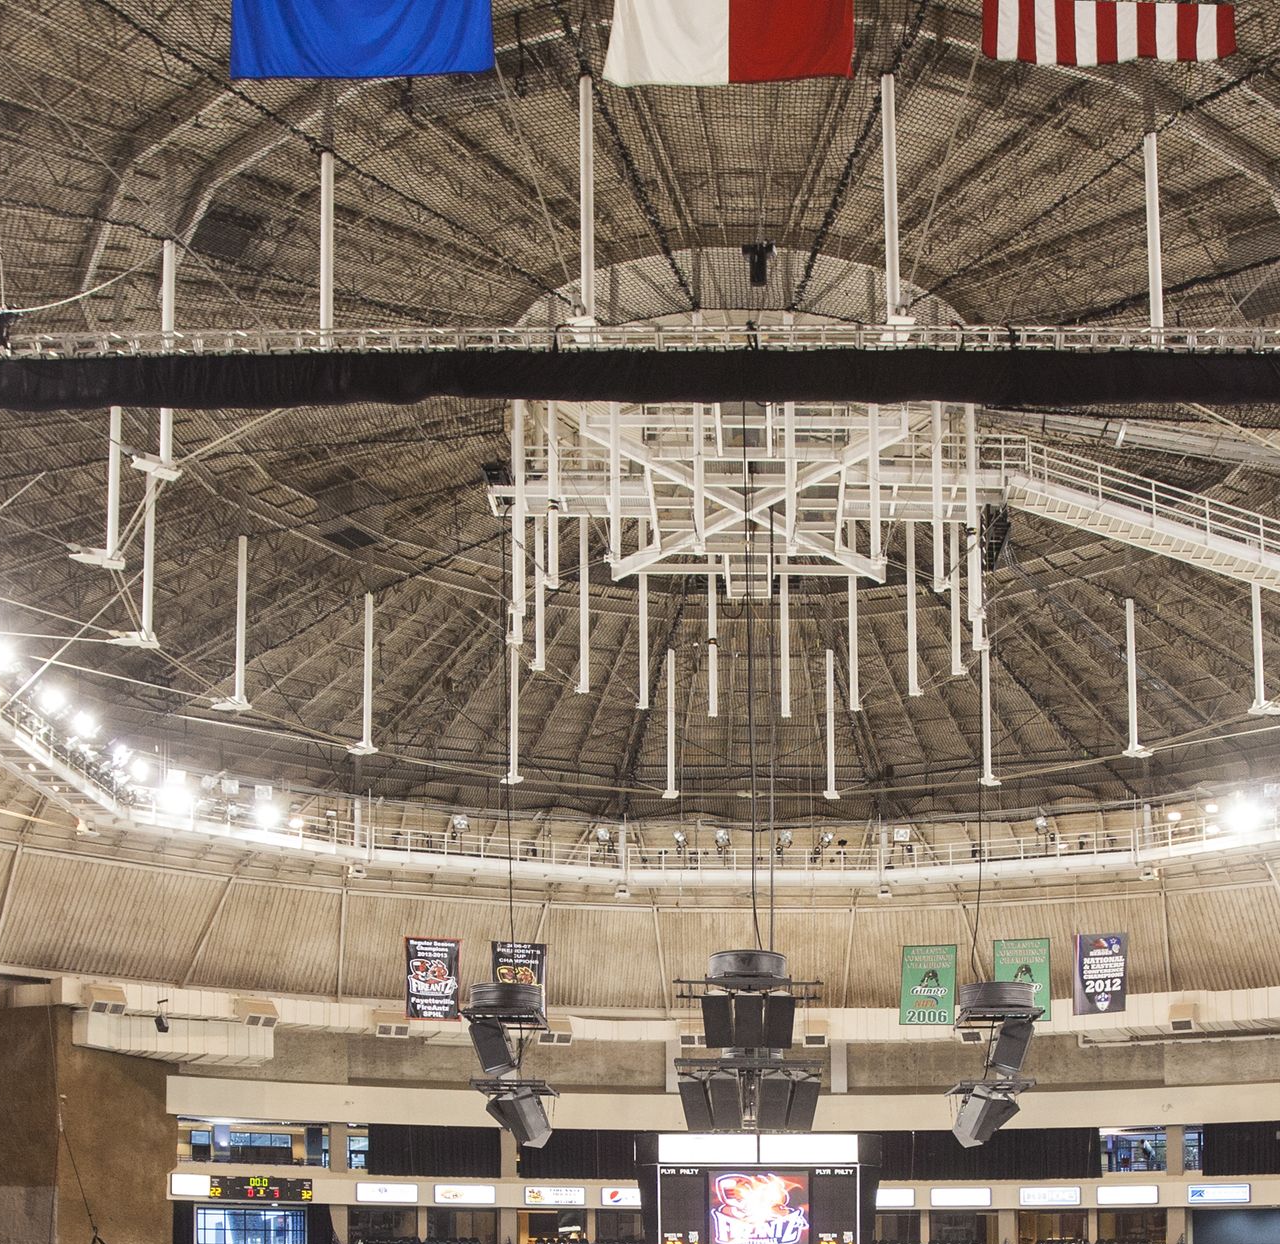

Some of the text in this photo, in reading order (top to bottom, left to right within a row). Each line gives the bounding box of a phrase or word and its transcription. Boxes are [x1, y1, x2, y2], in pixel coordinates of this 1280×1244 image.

[1083, 956, 1125, 964] NATIONAL
[1085, 978, 1122, 993] 2012
[907, 1010, 948, 1023] 2006
[209, 1188, 312, 1200] 22 0 3 32
